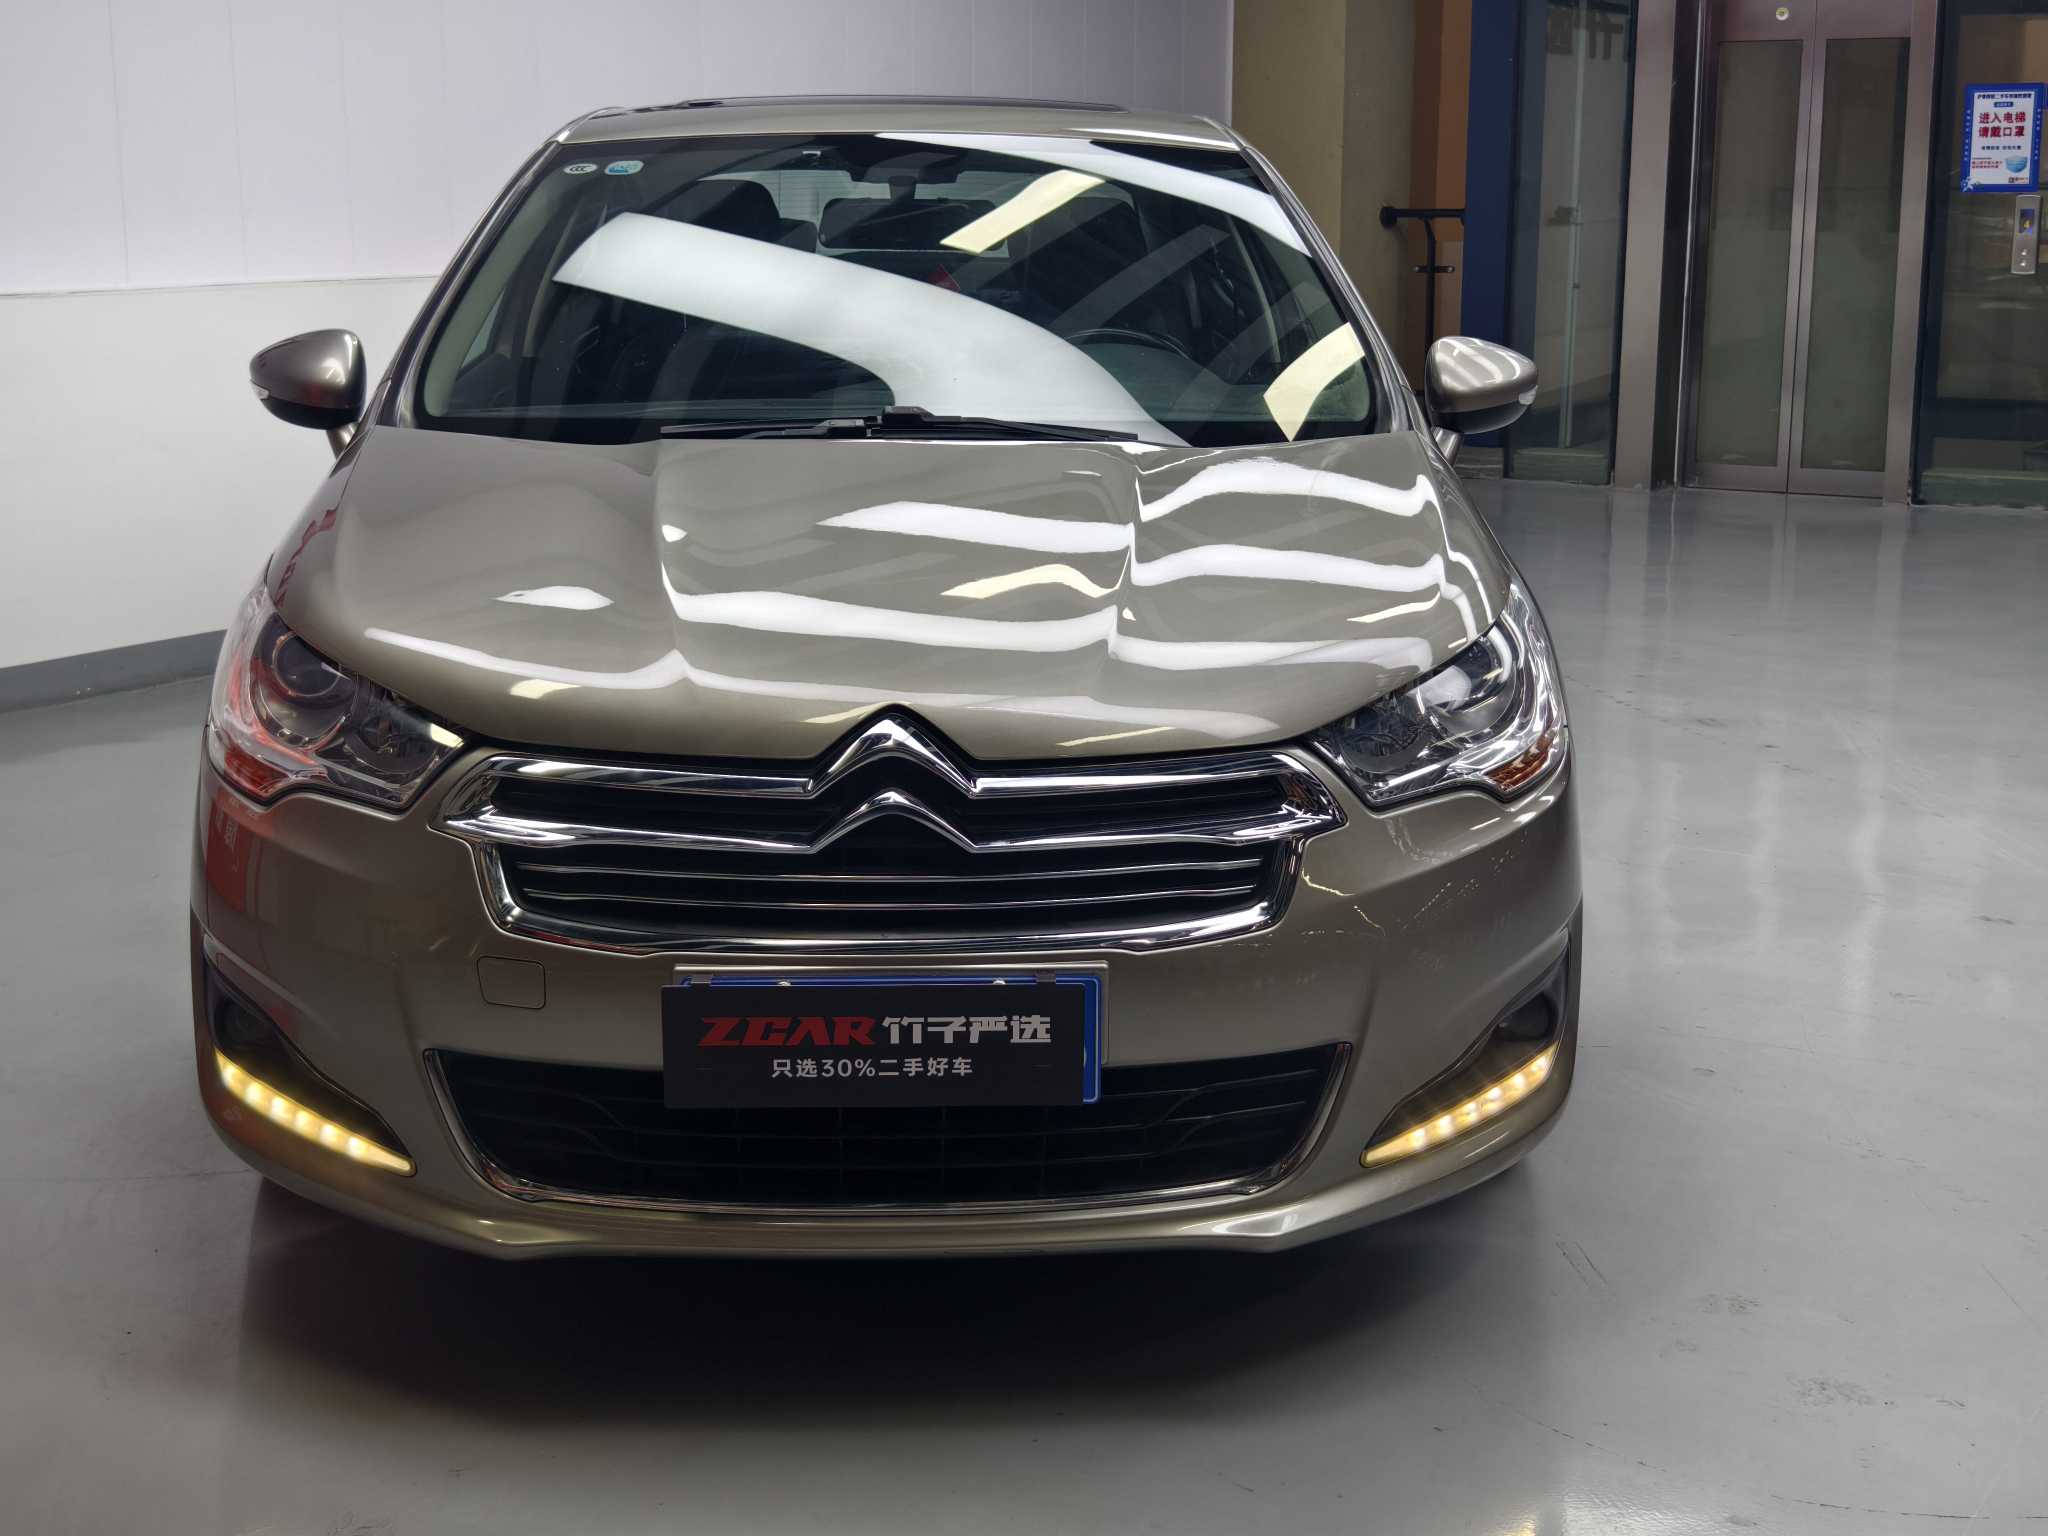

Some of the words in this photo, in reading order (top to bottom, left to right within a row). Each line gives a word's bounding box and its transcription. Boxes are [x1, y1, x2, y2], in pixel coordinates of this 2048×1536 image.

[1979, 112, 2026, 124] 进入电梯
[1978, 126, 2025, 138] 请戴口罩
[698, 1016, 876, 1046] ZCAR
[882, 1015, 1051, 1044] 竹子严选
[771, 1057, 973, 1078] 只选30%二手好车
